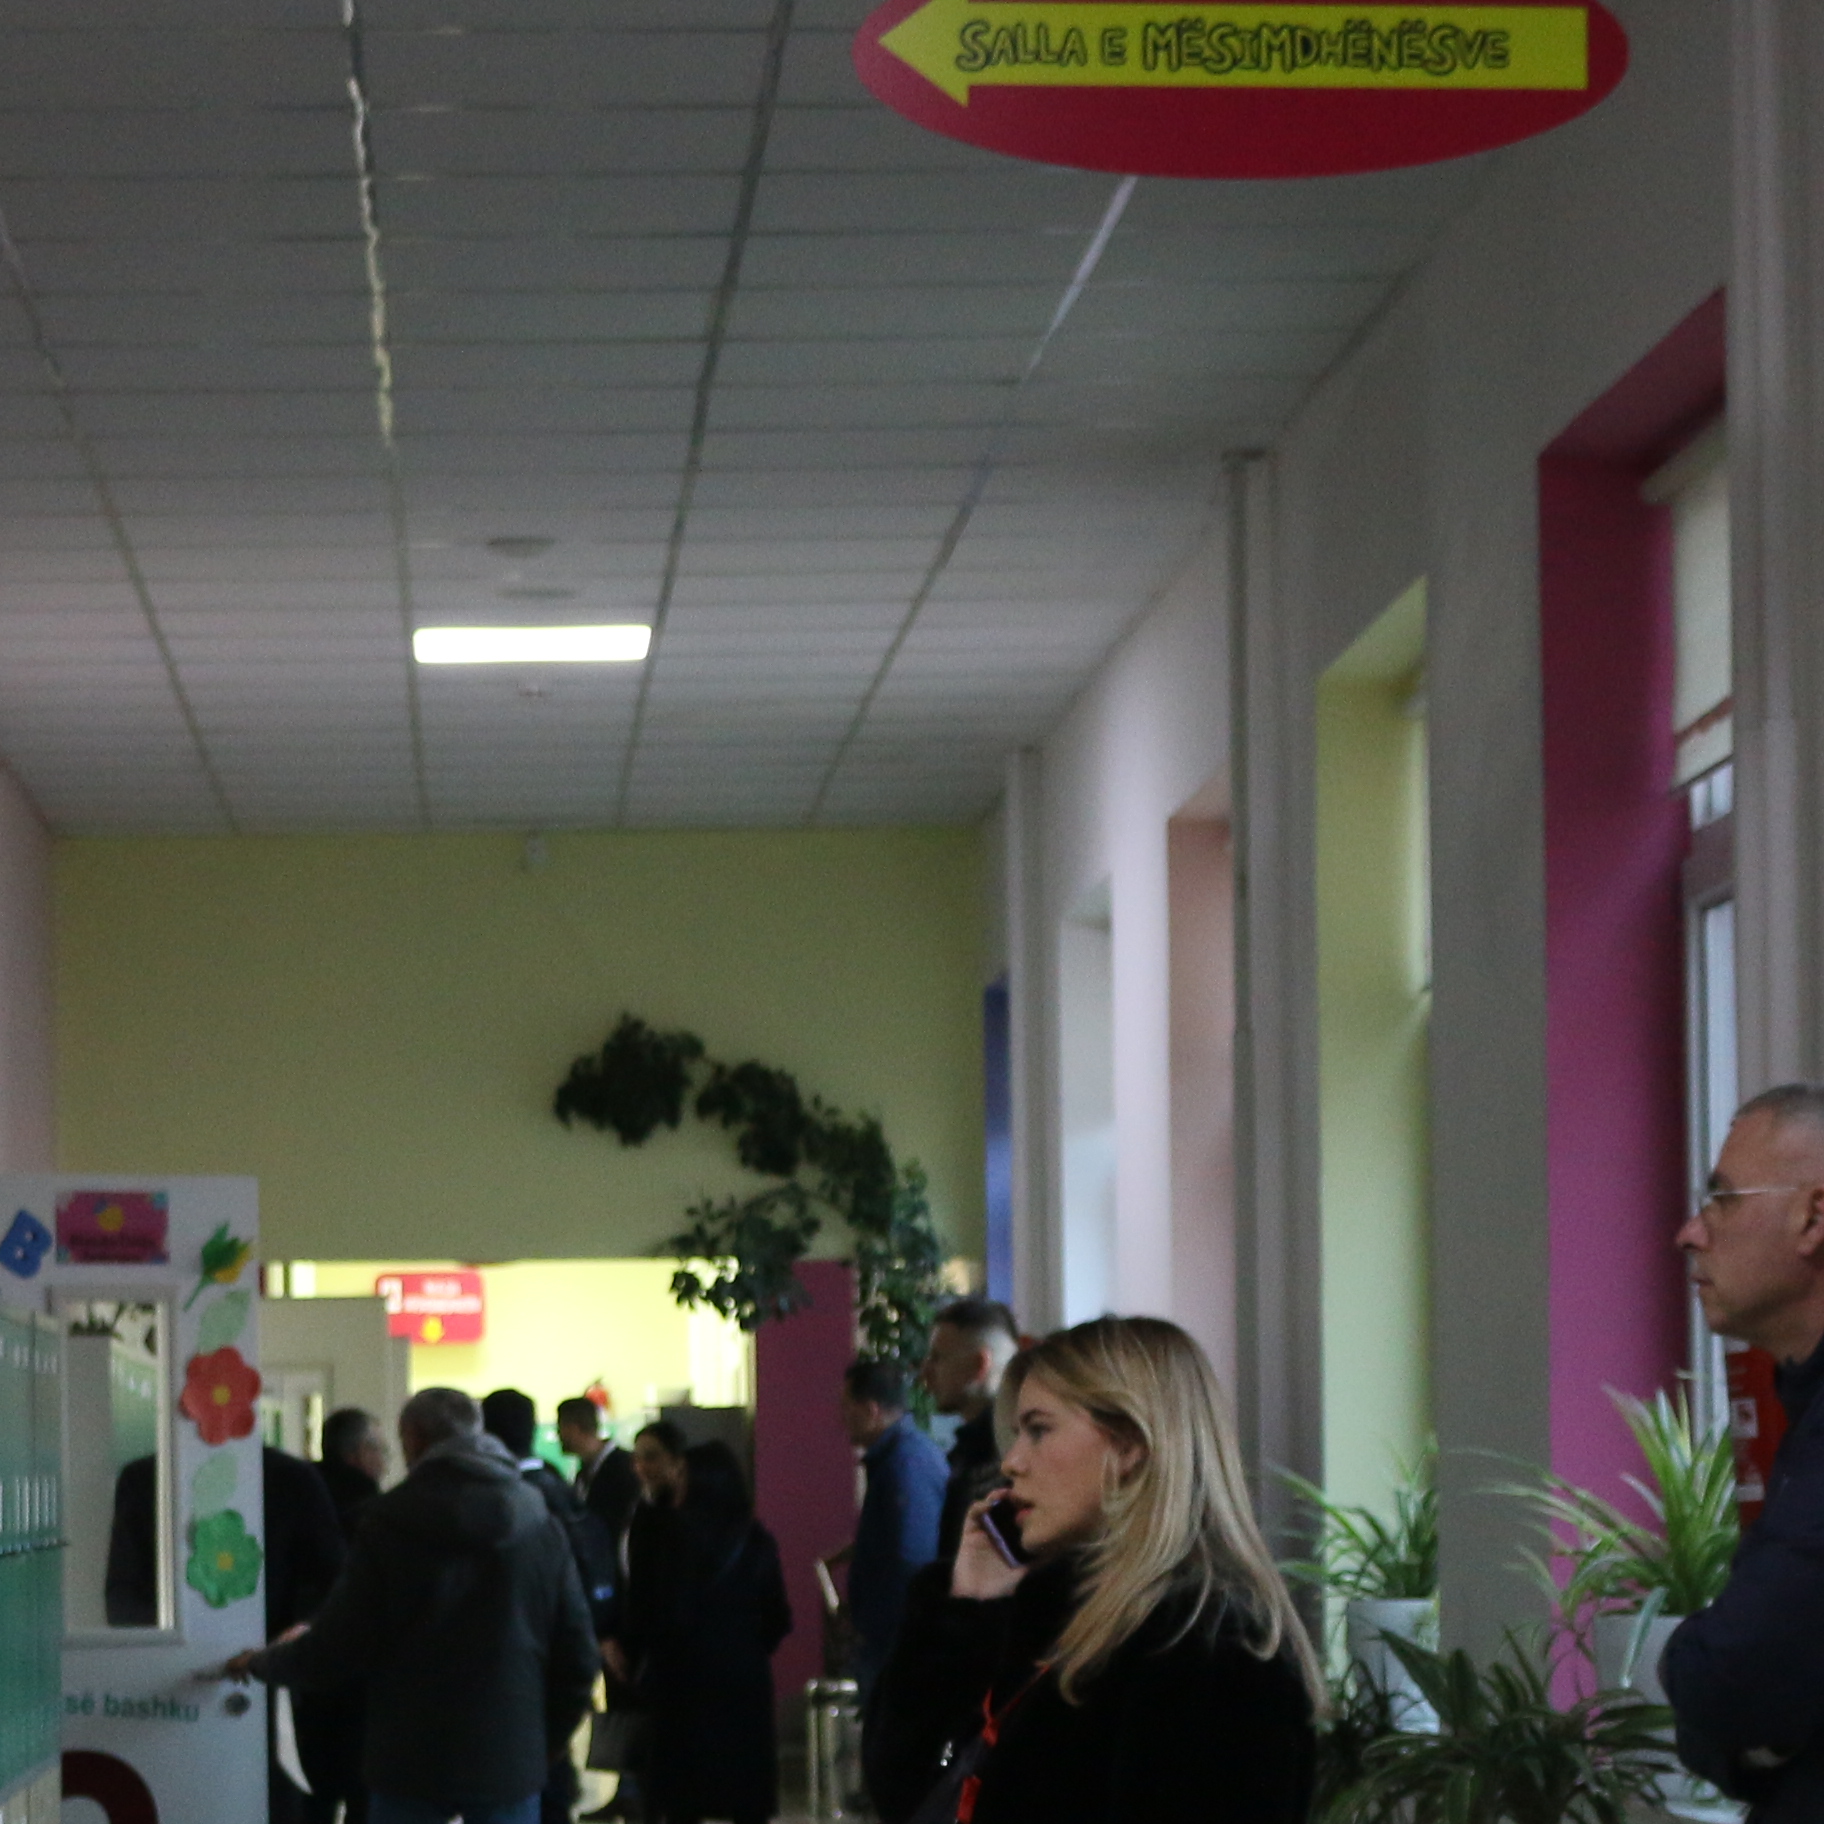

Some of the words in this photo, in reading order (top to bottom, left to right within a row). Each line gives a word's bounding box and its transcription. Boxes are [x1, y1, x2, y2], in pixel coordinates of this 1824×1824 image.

[955, 19, 1088, 72] SALLA
[1099, 26, 1127, 66] E
[1142, 17, 1511, 75] MËSIMDHËNËSVE
[104, 1693, 200, 1722] bashku
